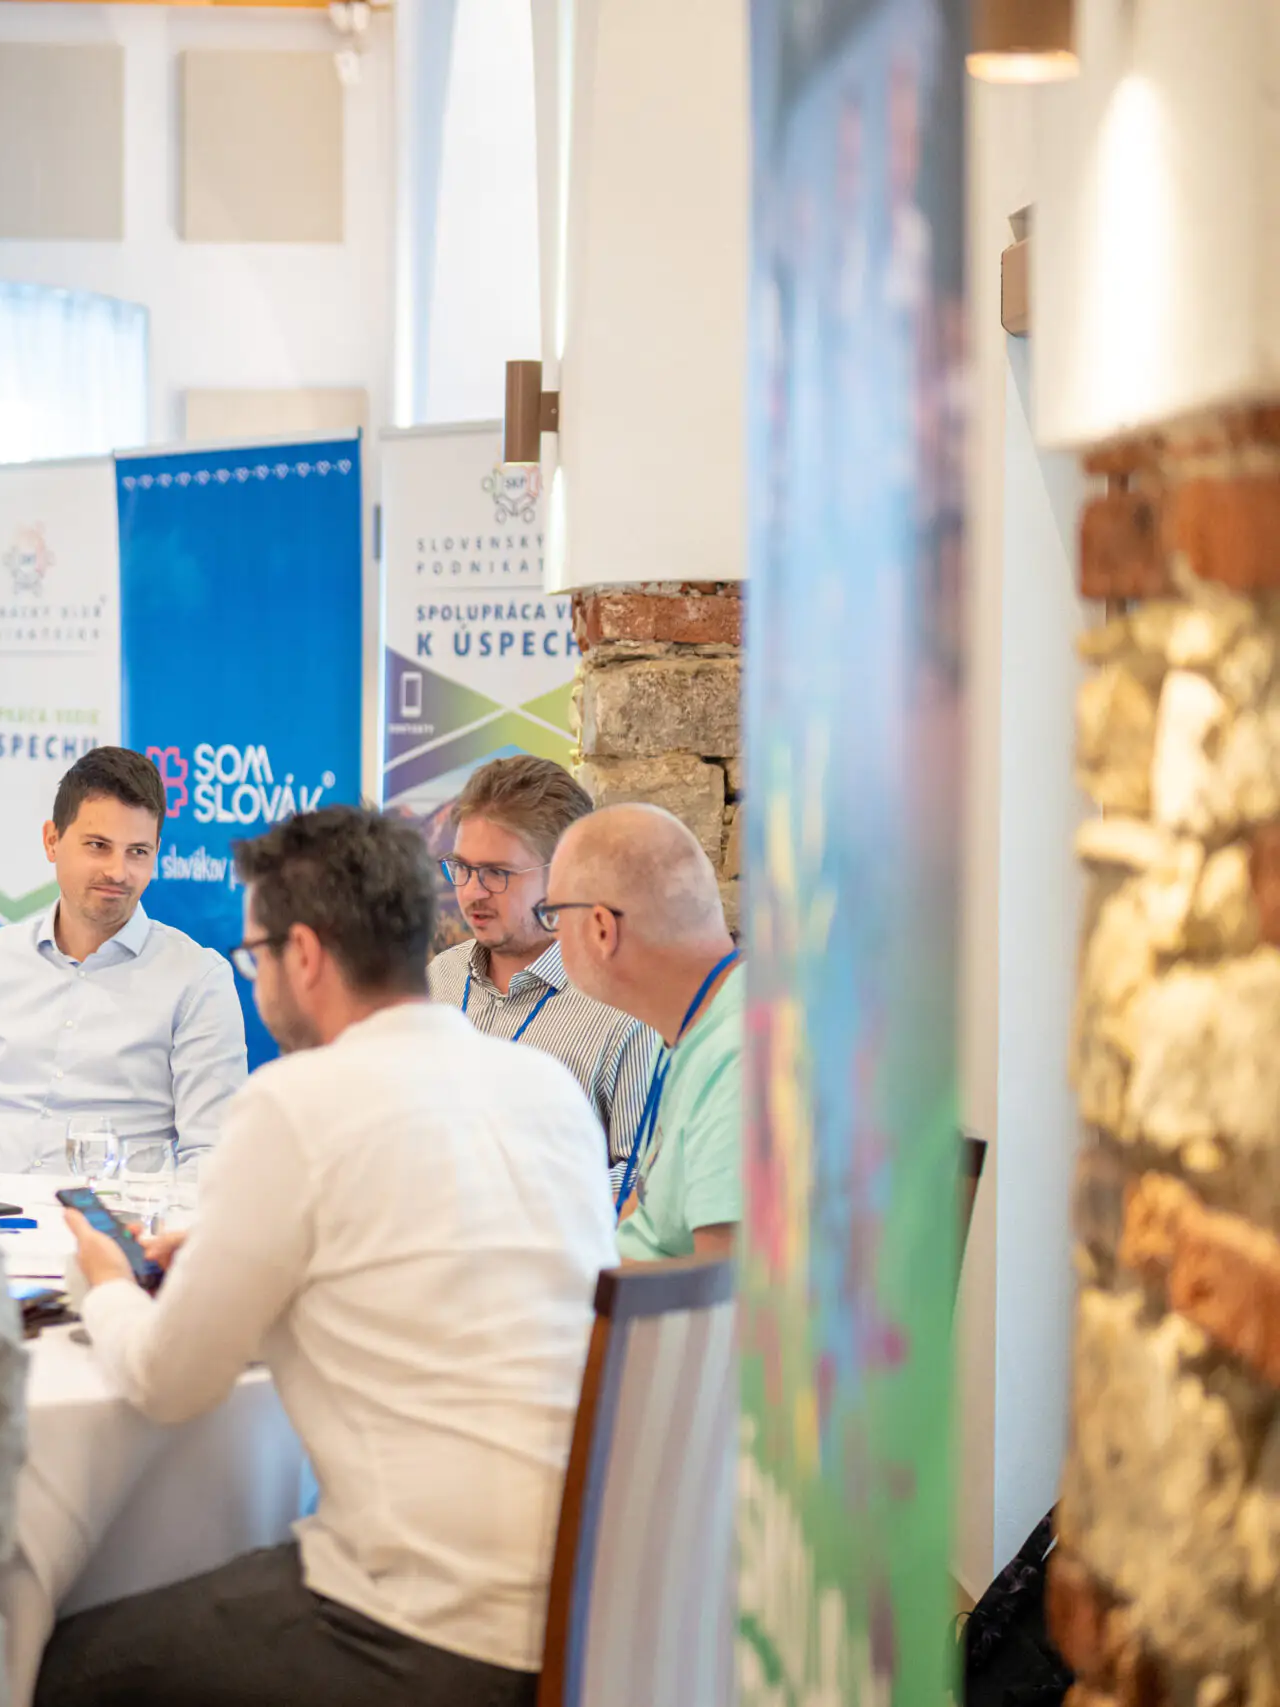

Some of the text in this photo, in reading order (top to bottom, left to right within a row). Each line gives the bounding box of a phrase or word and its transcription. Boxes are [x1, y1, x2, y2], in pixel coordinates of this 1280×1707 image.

[416, 558, 544, 576] PODNIKAT
[416, 600, 546, 622] SPOLUPRÁCA
[416, 623, 584, 657] K ÚSPECH
[193, 742, 275, 785] SOM
